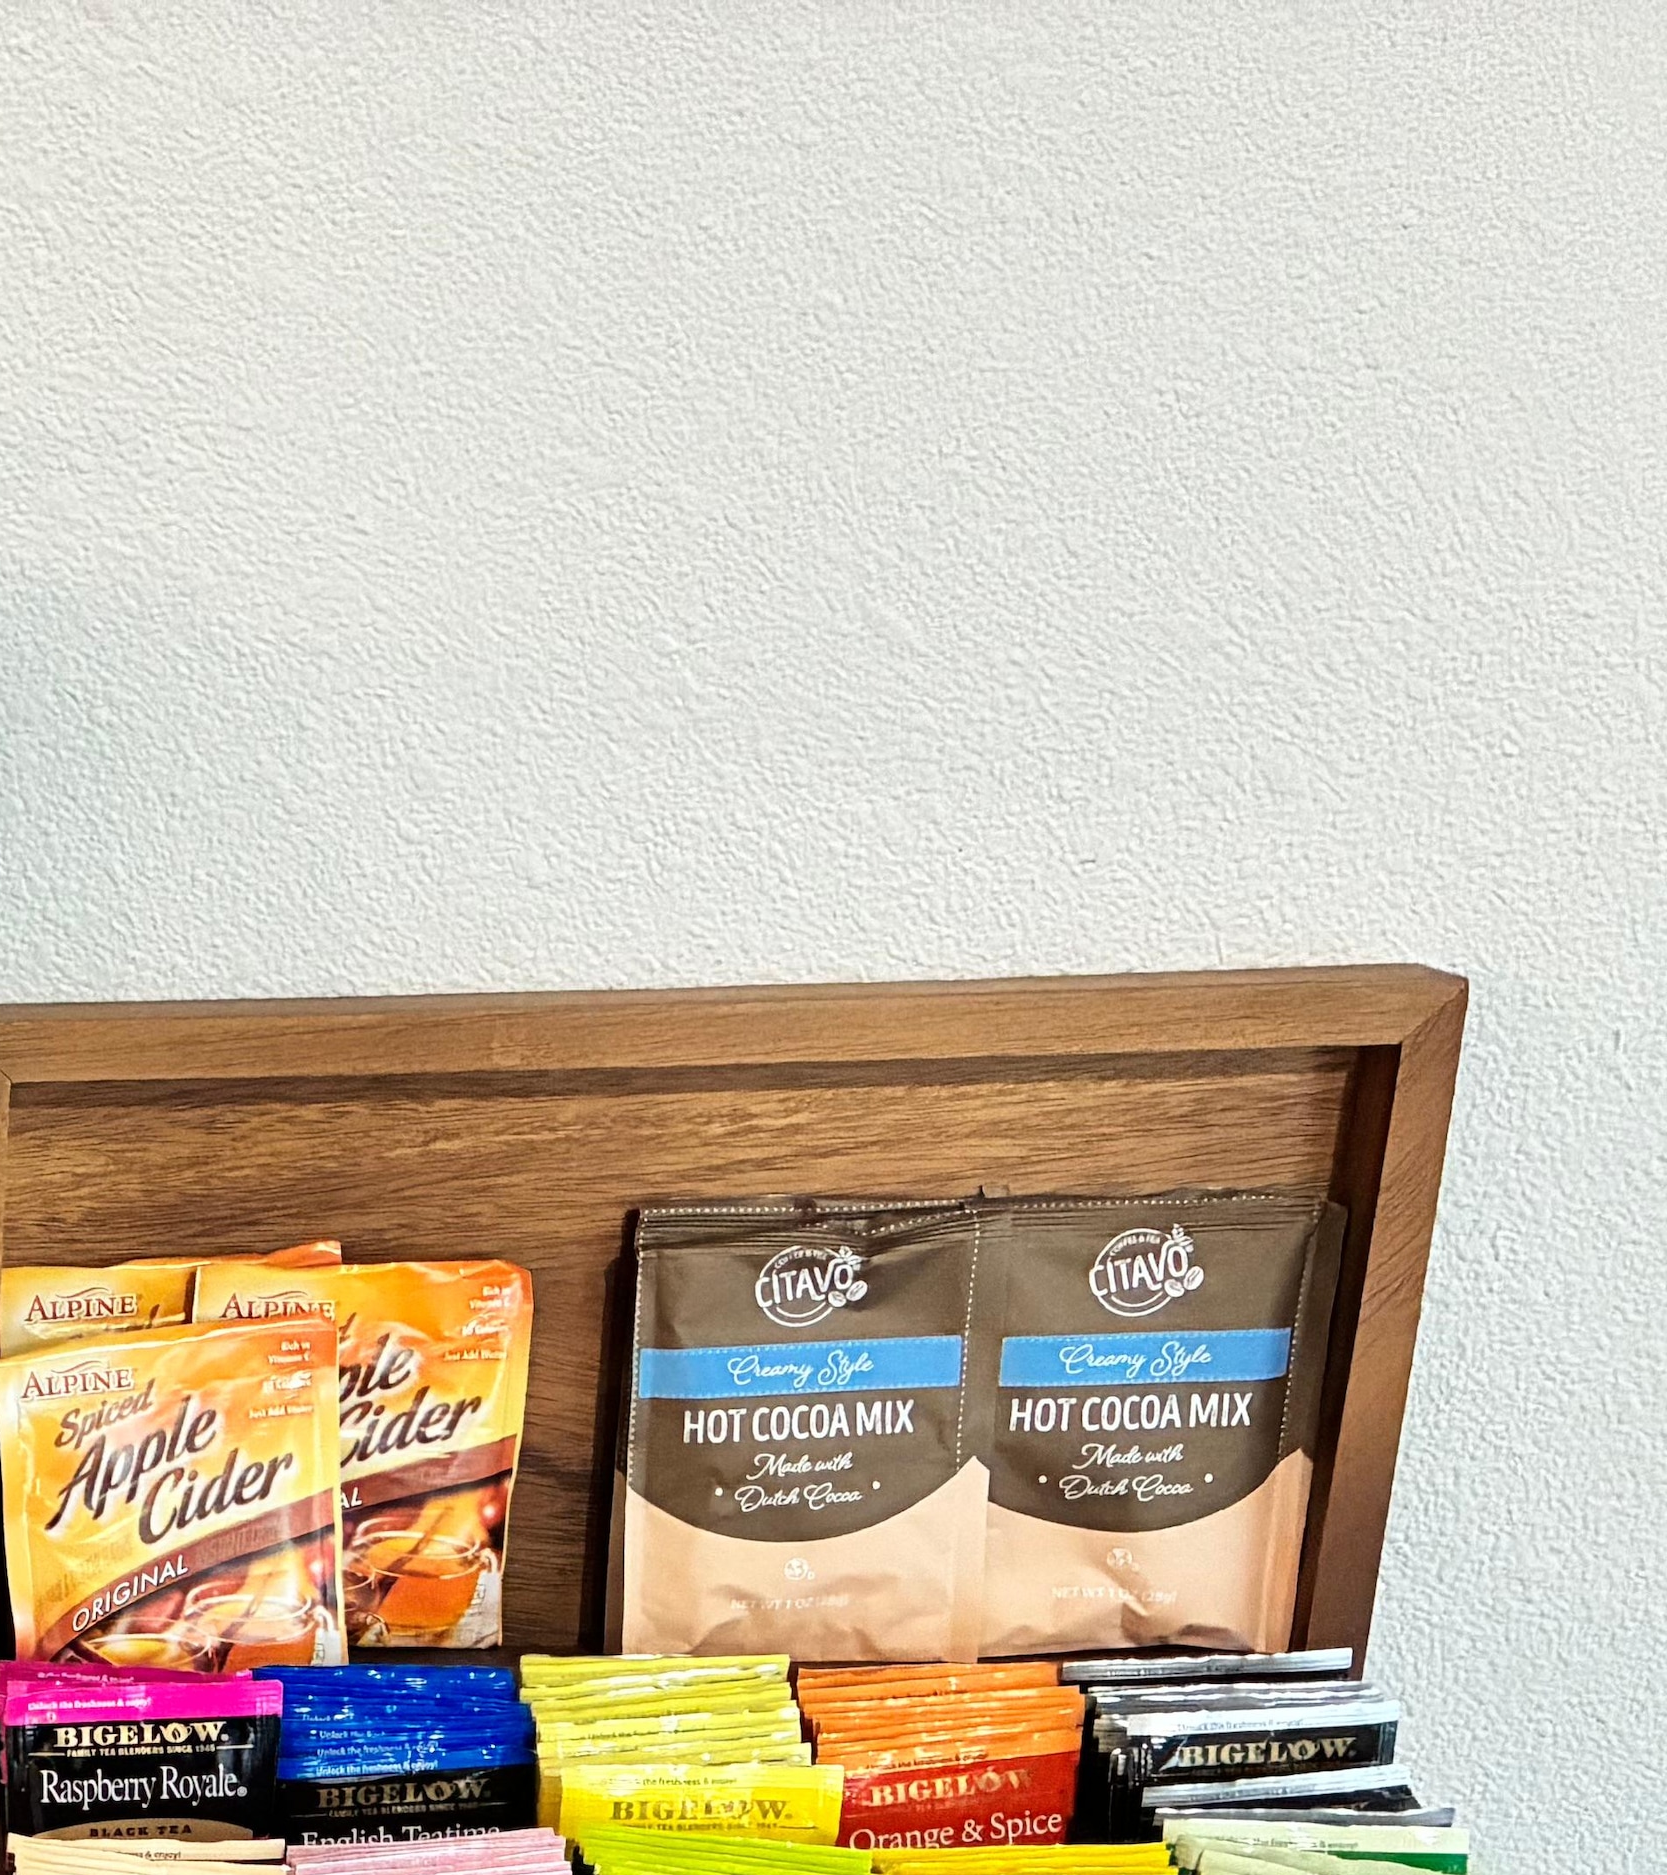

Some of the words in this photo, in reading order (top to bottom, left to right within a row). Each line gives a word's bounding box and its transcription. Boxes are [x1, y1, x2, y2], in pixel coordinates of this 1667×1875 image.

[755, 1256, 854, 1308] CITAVO
[1088, 1245, 1189, 1297] CITAVO
[24, 1294, 136, 1322] ALPINE
[219, 1297, 335, 1320] ALPINE
[339, 1333, 415, 1403] ple
[727, 1355, 813, 1387] Creamy
[818, 1349, 875, 1386] Style
[1059, 1345, 1146, 1378] Creamy
[1150, 1341, 1213, 1376] Style
[21, 1366, 134, 1399] ALPINE
[54, 1389, 156, 1449] Spiced
[683, 1408, 746, 1443] HOT
[752, 1404, 850, 1442] COCOA
[856, 1400, 914, 1435] MIX
[1009, 1397, 1077, 1432] HOT
[1082, 1394, 1181, 1431] COCOA
[1189, 1392, 1253, 1428] MIX
[44, 1396, 218, 1532] Apple
[746, 1454, 813, 1480] Made
[815, 1452, 853, 1472] with
[1072, 1443, 1143, 1471] Made
[1145, 1443, 1185, 1464] with
[138, 1447, 293, 1545] Cider
[735, 1485, 800, 1511] Dutch
[804, 1482, 862, 1510] Cocoa
[1059, 1474, 1128, 1500] Dutch
[1132, 1476, 1194, 1501] Cocoa
[71, 1553, 189, 1633] ORIGINAL
[53, 1721, 228, 1749] BIGELOW
[99, 1749, 116, 1757] TEA
[1178, 1737, 1356, 1767] BIGELOW
[40, 1768, 157, 1811] Raspberry
[318, 1778, 489, 1808] BIGELOW
[867, 1767, 1032, 1808] BIGELOW
[90, 1826, 154, 1838] BLACK
[158, 1824, 192, 1836] TEA
[849, 1826, 955, 1849] Orange
[961, 1819, 984, 1843] &
[990, 1809, 1063, 1845] Spice
